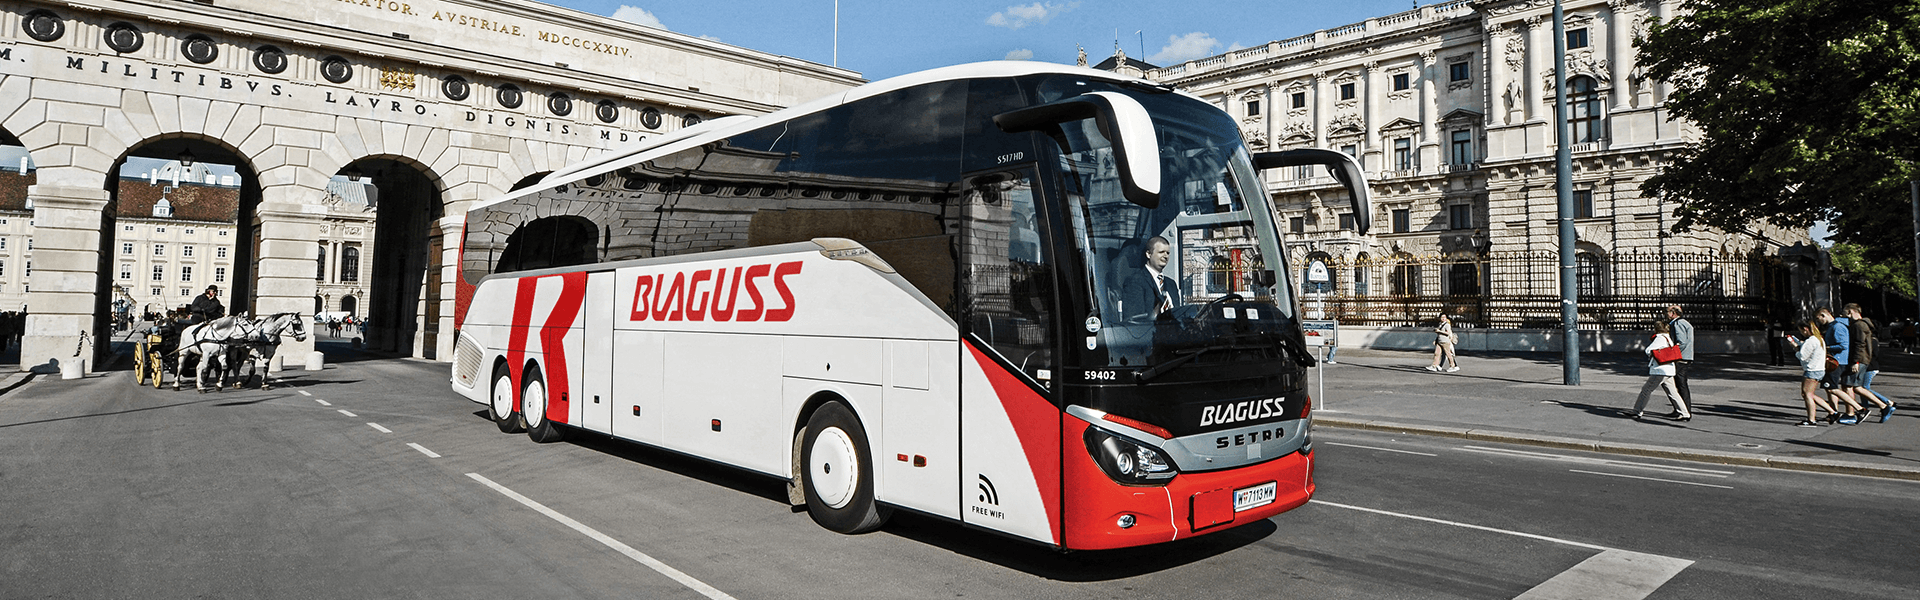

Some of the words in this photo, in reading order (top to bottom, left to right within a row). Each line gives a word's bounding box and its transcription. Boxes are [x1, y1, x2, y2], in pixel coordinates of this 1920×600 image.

[630, 260, 803, 322] BLAGUSS
[1084, 370, 1116, 380] 59402
[1200, 396, 1285, 427] BLAGUSS
[1216, 427, 1285, 449] SETRA
[971, 505, 988, 516] FREE
[989, 509, 1005, 520] WIFI
